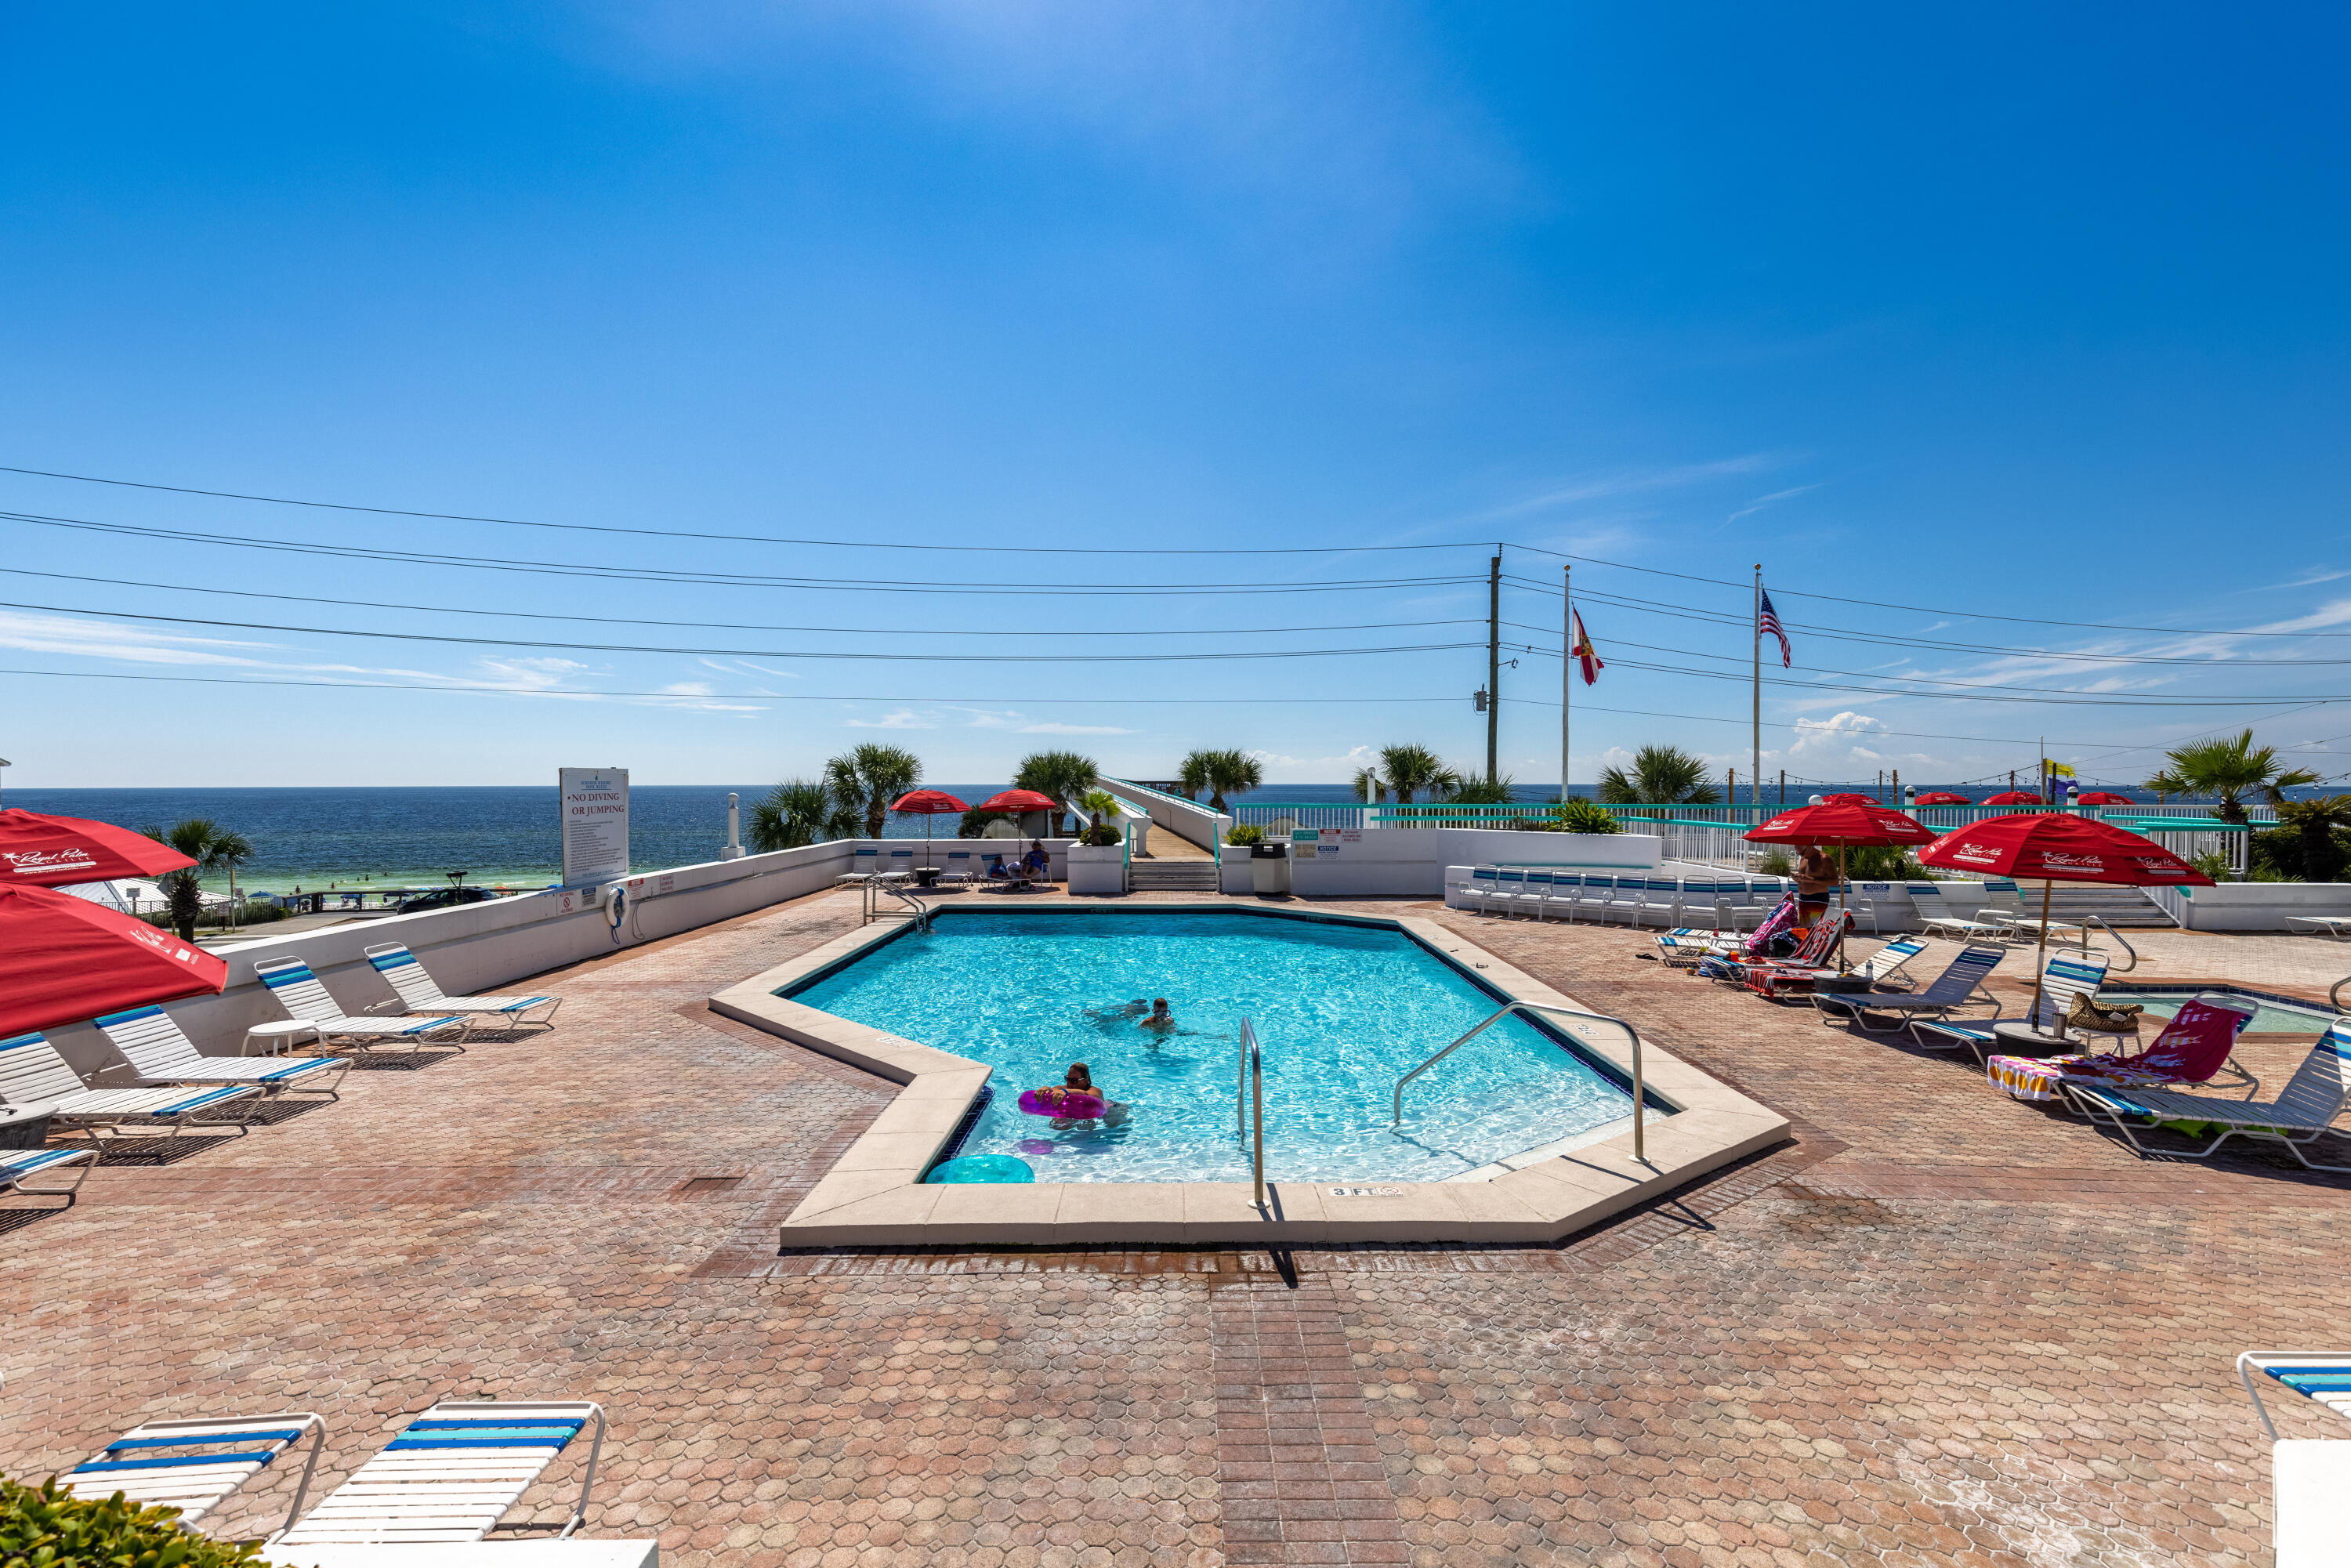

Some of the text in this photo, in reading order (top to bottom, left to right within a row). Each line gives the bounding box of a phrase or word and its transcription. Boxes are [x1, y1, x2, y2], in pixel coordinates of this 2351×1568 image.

[571, 793, 619, 802] NO DIVING
[571, 805, 625, 817] OR JUMPING
[20, 848, 89, 865] Royal Palm
[2051, 853, 2081, 864] Royal
